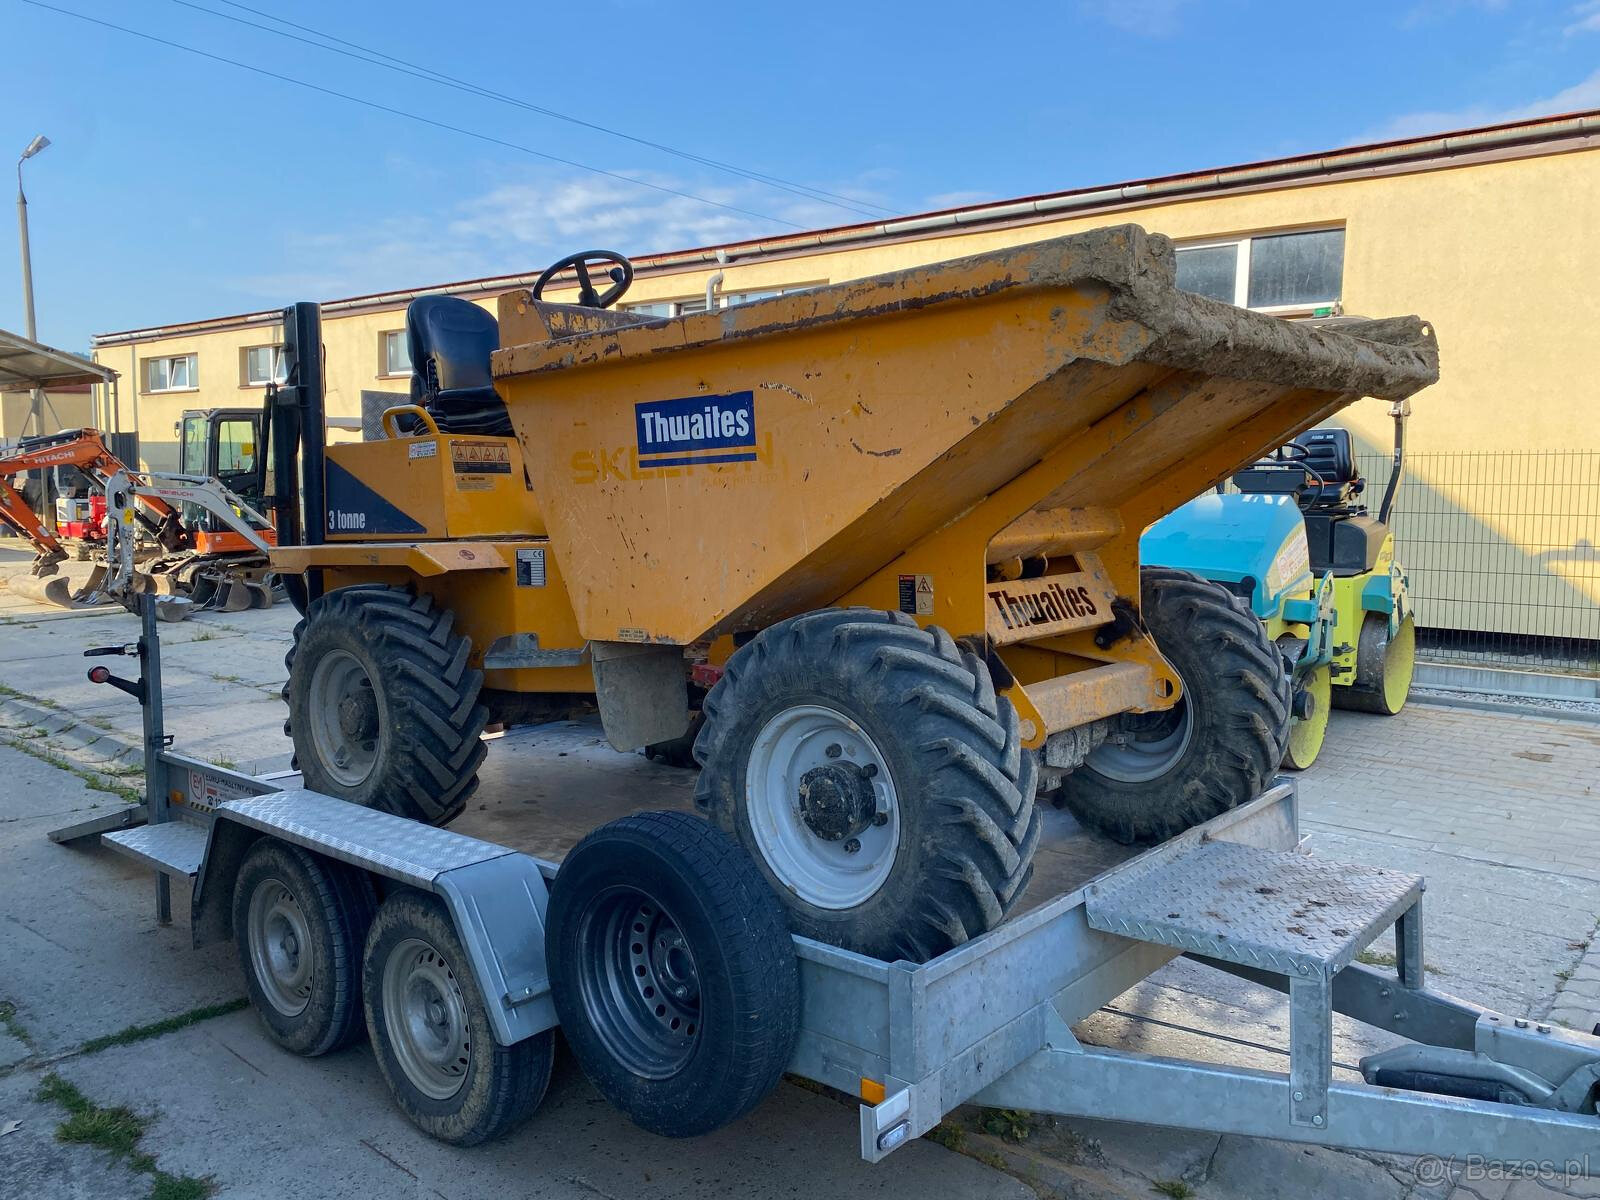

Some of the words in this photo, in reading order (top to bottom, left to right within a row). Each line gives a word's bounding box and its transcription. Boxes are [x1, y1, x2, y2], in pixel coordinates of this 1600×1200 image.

[641, 405, 750, 444] Thwaites
[34, 450, 75, 464] HITACHI
[328, 510, 335, 530] 3
[337, 509, 366, 530] tonne
[988, 583, 1097, 631] Thwaites
